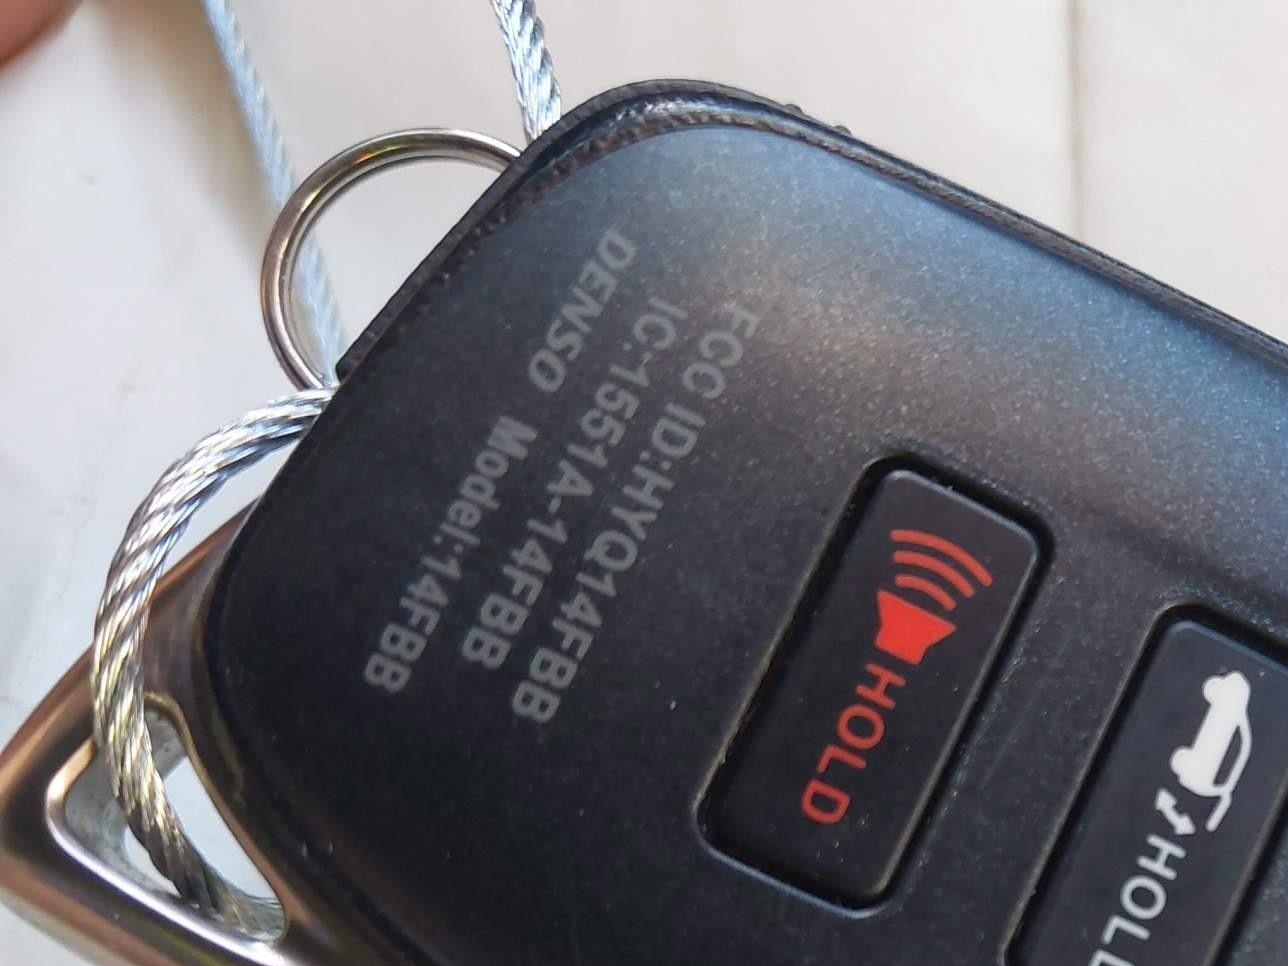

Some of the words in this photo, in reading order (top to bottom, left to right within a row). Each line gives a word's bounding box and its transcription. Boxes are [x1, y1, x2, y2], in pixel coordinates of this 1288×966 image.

[529, 228, 636, 393] DENSO
[683, 307, 760, 400] FCC
[365, 414, 536, 693] Model:14FBB
[461, 297, 687, 670] IC:1551A-14FBB
[511, 402, 706, 724] ID:HYQ14FBB
[801, 664, 906, 826] HOLD
